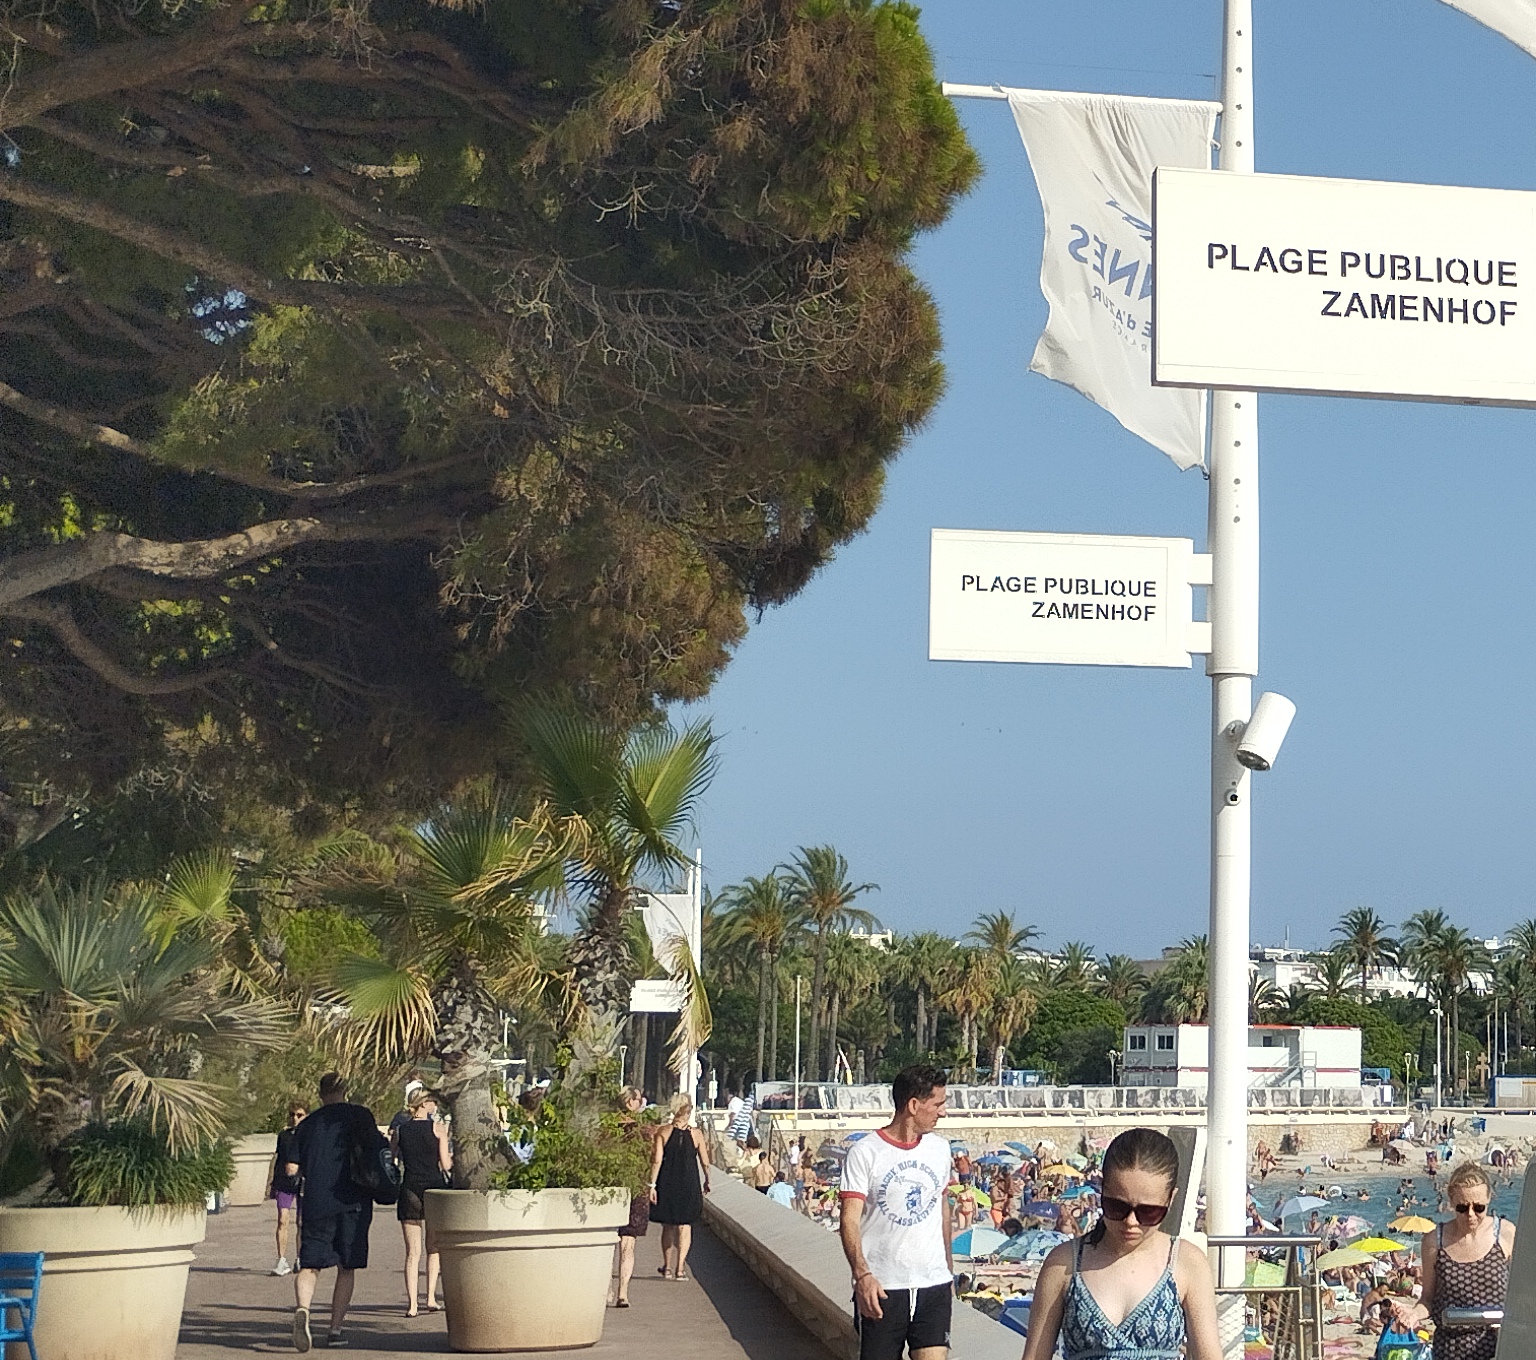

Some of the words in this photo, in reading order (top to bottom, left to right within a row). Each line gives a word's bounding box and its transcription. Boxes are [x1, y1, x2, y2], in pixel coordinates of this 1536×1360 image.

[1206, 242, 1328, 278] PLAGE
[1340, 251, 1518, 289] PUBLIQUE
[1320, 290, 1518, 327] ZAMENHOF
[961, 574, 1038, 594] PLAGE
[1044, 577, 1157, 598] PUBLIQUE
[1031, 601, 1157, 622] ZAMENHOF
